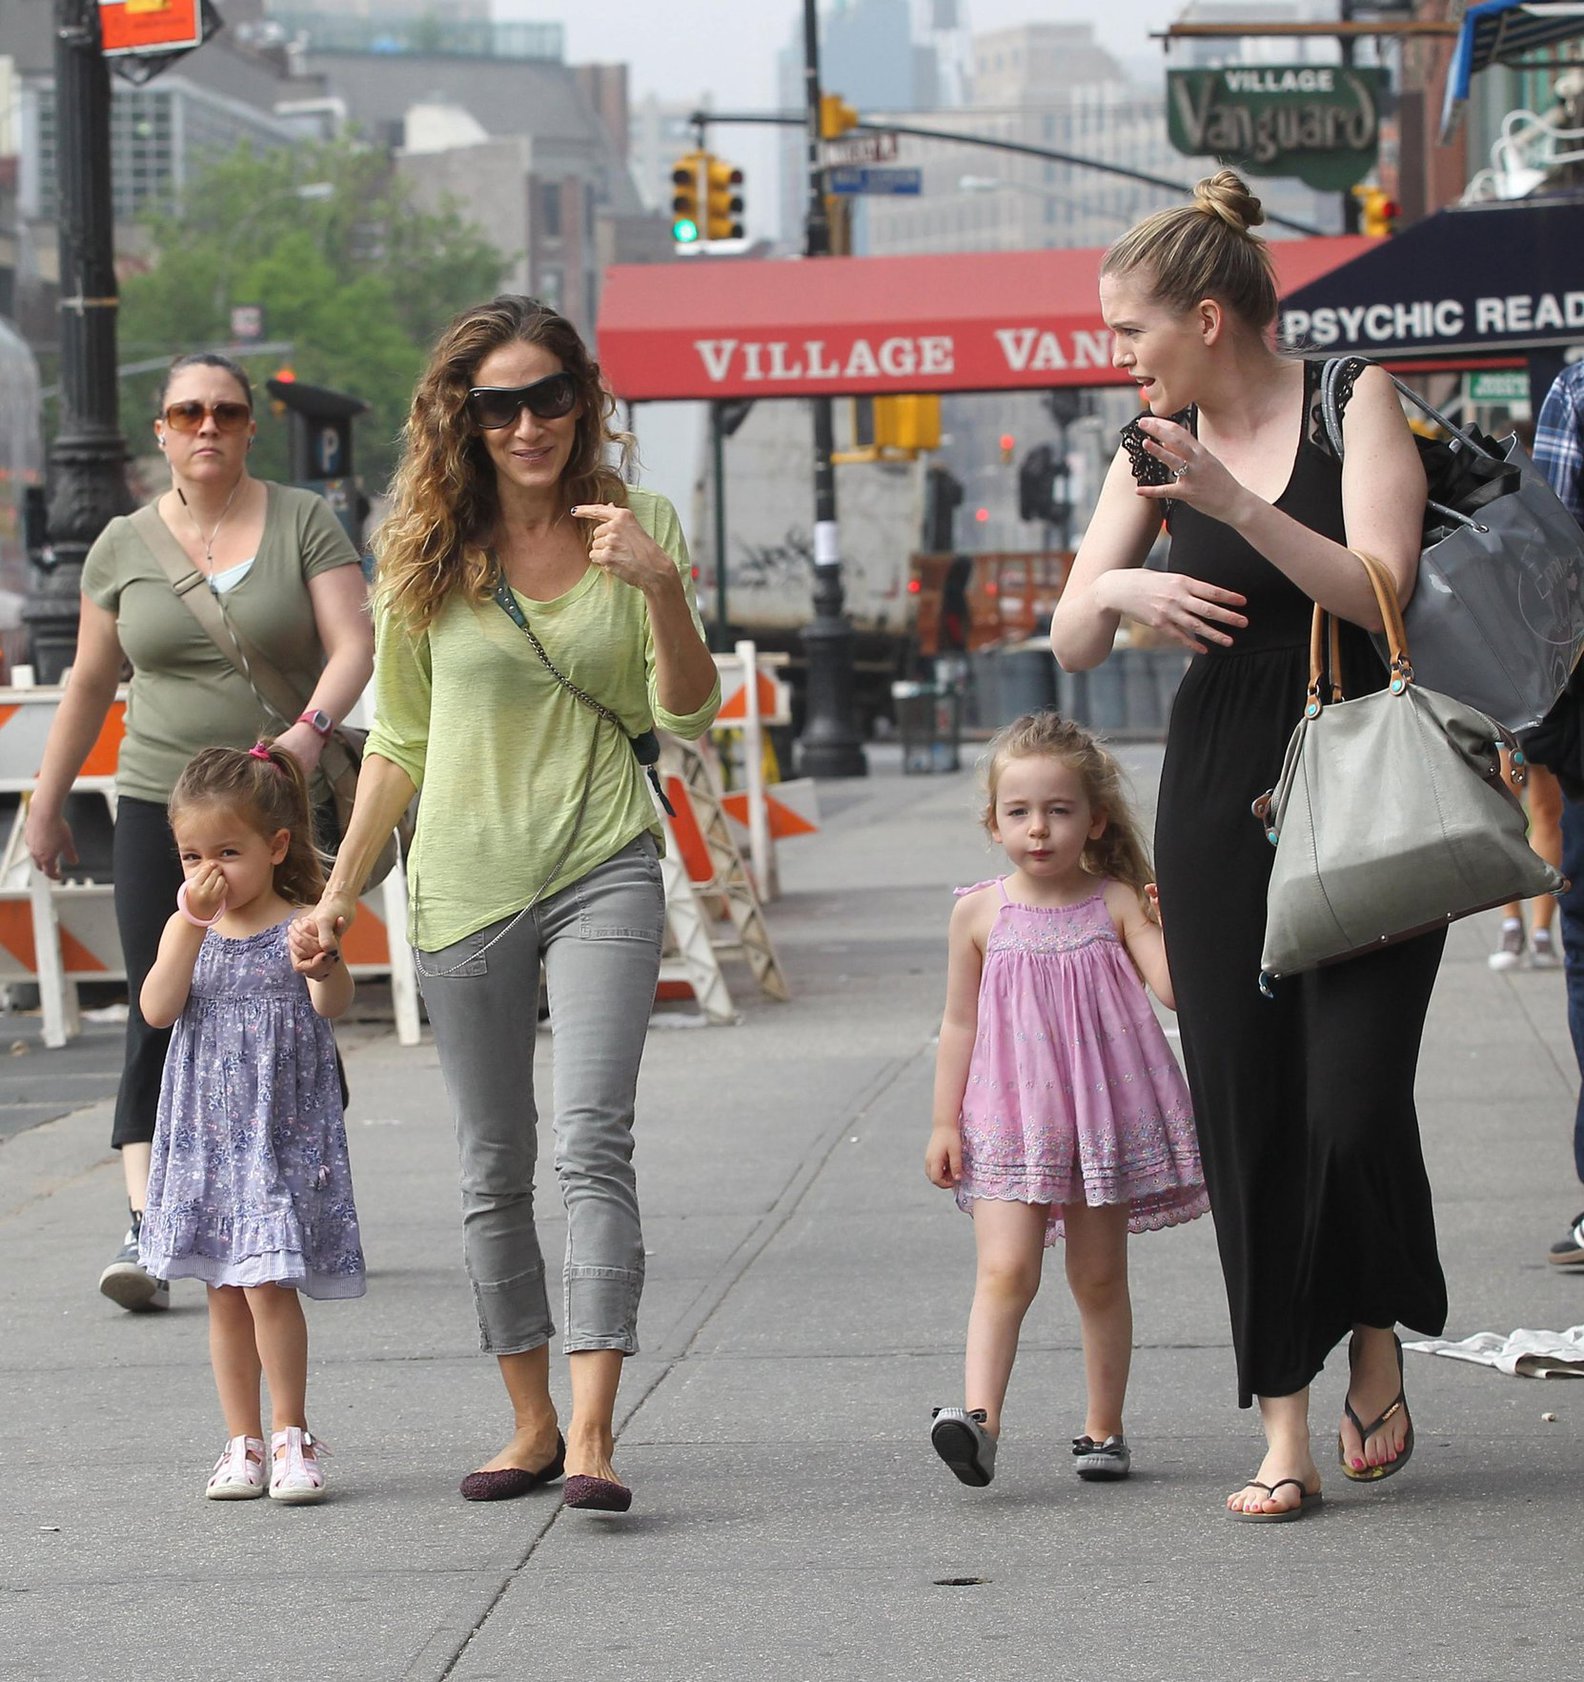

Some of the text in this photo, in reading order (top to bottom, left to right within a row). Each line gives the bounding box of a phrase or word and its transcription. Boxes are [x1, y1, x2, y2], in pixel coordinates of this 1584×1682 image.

[1225, 69, 1335, 92] VILLAGE
[1172, 72, 1376, 163] Vanguard
[1282, 291, 1584, 345] PSYCHIC READ
[693, 335, 955, 382] VILLAGE
[321, 427, 340, 473] P
